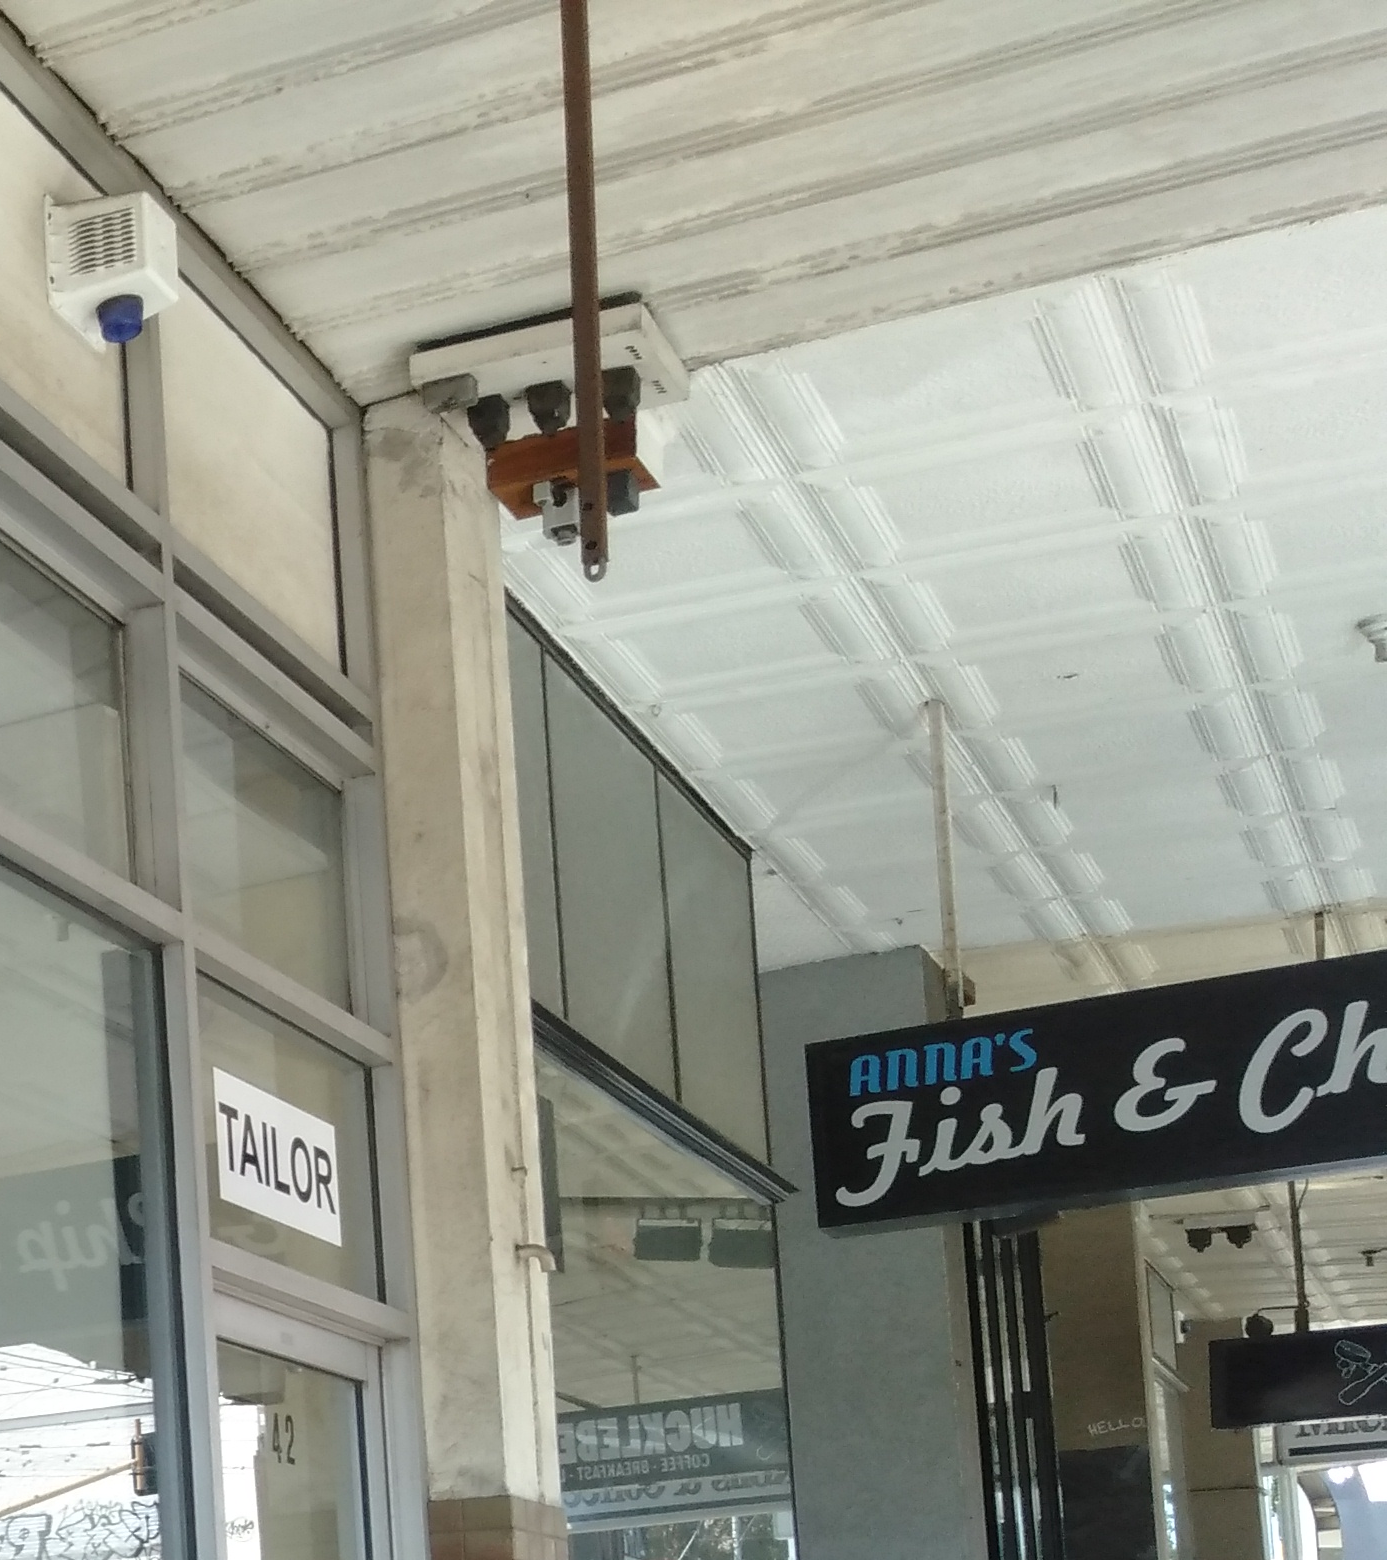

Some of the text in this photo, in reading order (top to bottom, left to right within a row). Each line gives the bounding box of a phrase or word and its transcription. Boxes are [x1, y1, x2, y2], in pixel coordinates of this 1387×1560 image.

[849, 1028, 1039, 1097] ANNA'S
[219, 1103, 337, 1214] TAILOR
[835, 1066, 1086, 1207] Fish
[1113, 1037, 1217, 1132] &
[272, 1412, 295, 1465] 42
